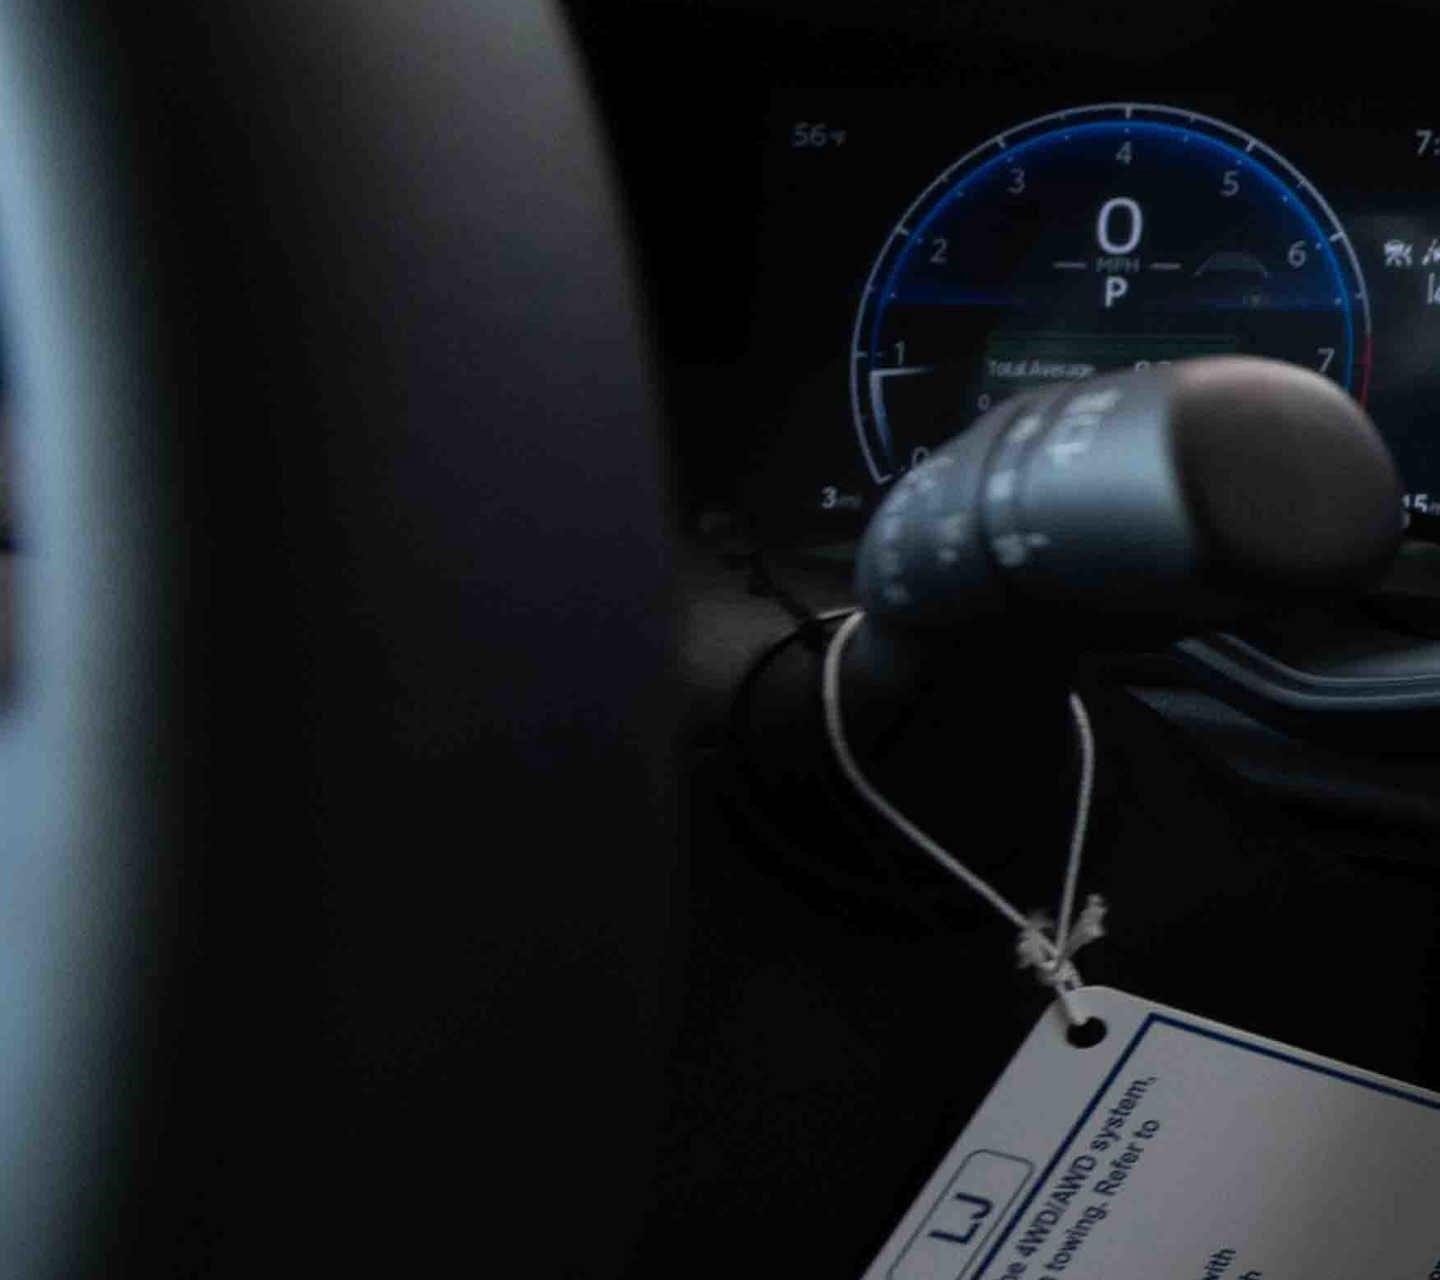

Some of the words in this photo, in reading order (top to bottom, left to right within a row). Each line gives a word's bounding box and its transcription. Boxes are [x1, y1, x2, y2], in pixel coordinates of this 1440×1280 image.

[1114, 138, 1133, 164] 4
[1007, 166, 1027, 194] 3
[1220, 169, 1241, 197] 5
[1097, 197, 1143, 255] 0
[930, 237, 948, 264] 2
[1288, 240, 1307, 268] 6
[1105, 276, 1128, 307] P
[895, 341, 905, 366] 1
[1315, 350, 1336, 375] 7
[988, 359, 1028, 378] Total
[928, 1191, 994, 1245] LJ
[1015, 1155, 1097, 1258] 4WD/AWD
